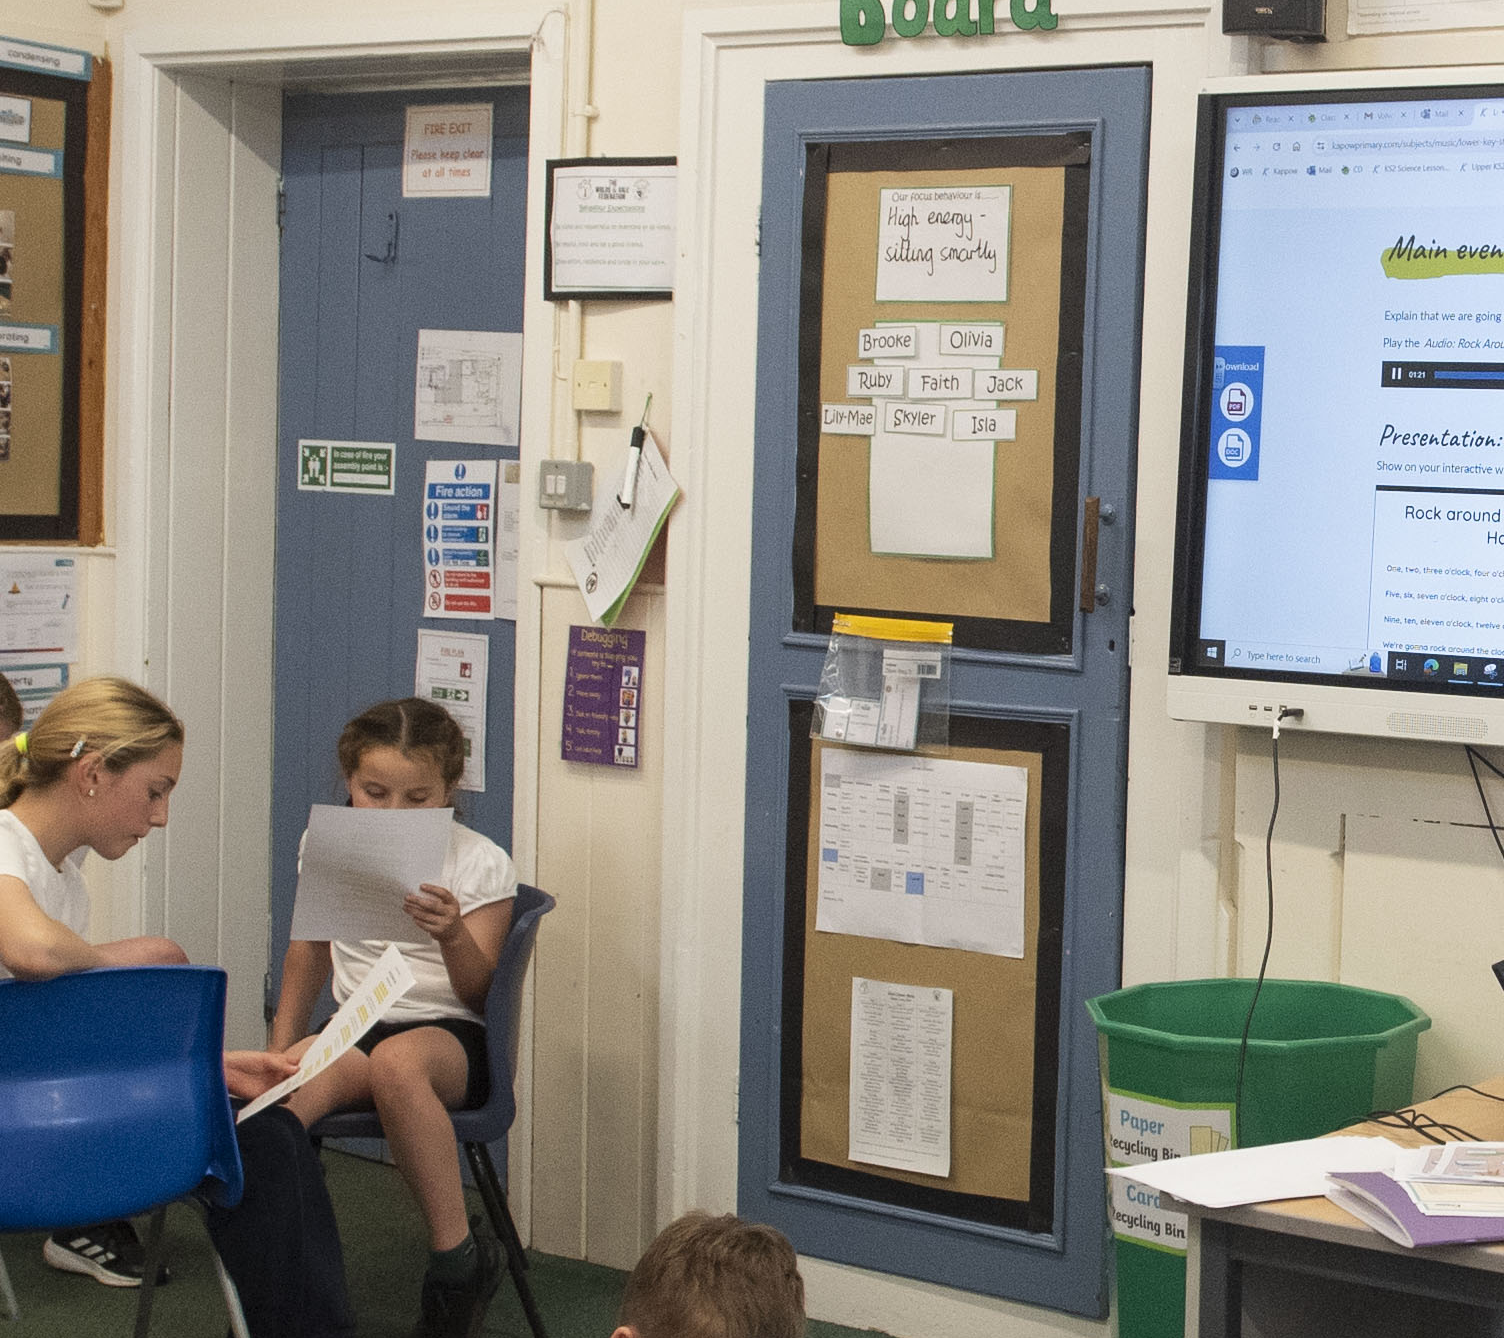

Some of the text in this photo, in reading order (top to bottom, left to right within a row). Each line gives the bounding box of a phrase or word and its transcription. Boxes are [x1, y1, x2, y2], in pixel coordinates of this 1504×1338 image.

[424, 123, 472, 135] FIRE EXIT
[892, 191, 972, 202] Our focus behaviour
[888, 206, 973, 240] High energy
[885, 236, 996, 276] sitting smartly
[1388, 234, 1447, 261] Main
[1384, 311, 1418, 322] Explain
[1420, 311, 1439, 321] that
[1441, 313, 1455, 321] we
[1475, 312, 1501, 324] going
[863, 330, 993, 351] Brooke Olivia
[1383, 338, 1403, 350] Play
[1405, 338, 1419, 348] the
[1424, 338, 1456, 349] Audio:
[1458, 339, 1481, 349] Rock
[858, 372, 1023, 393] Ruby Faith Jack
[824, 409, 996, 434] Lily-Mae Skyler Isla
[1379, 424, 1503, 448] Presentation:
[1376, 461, 1402, 472] Show
[1404, 463, 1416, 472] on
[1419, 464, 1440, 475] your
[1442, 463, 1493, 474] interactive
[435, 486, 483, 497] Fire action
[1405, 506, 1442, 521] Rock
[1446, 509, 1501, 523] around
[581, 628, 629, 649] Debugging
[1247, 651, 1320, 664] Type here to search
[1120, 1110, 1164, 1136] Paper
[1165, 1222, 1185, 1239] Bin
